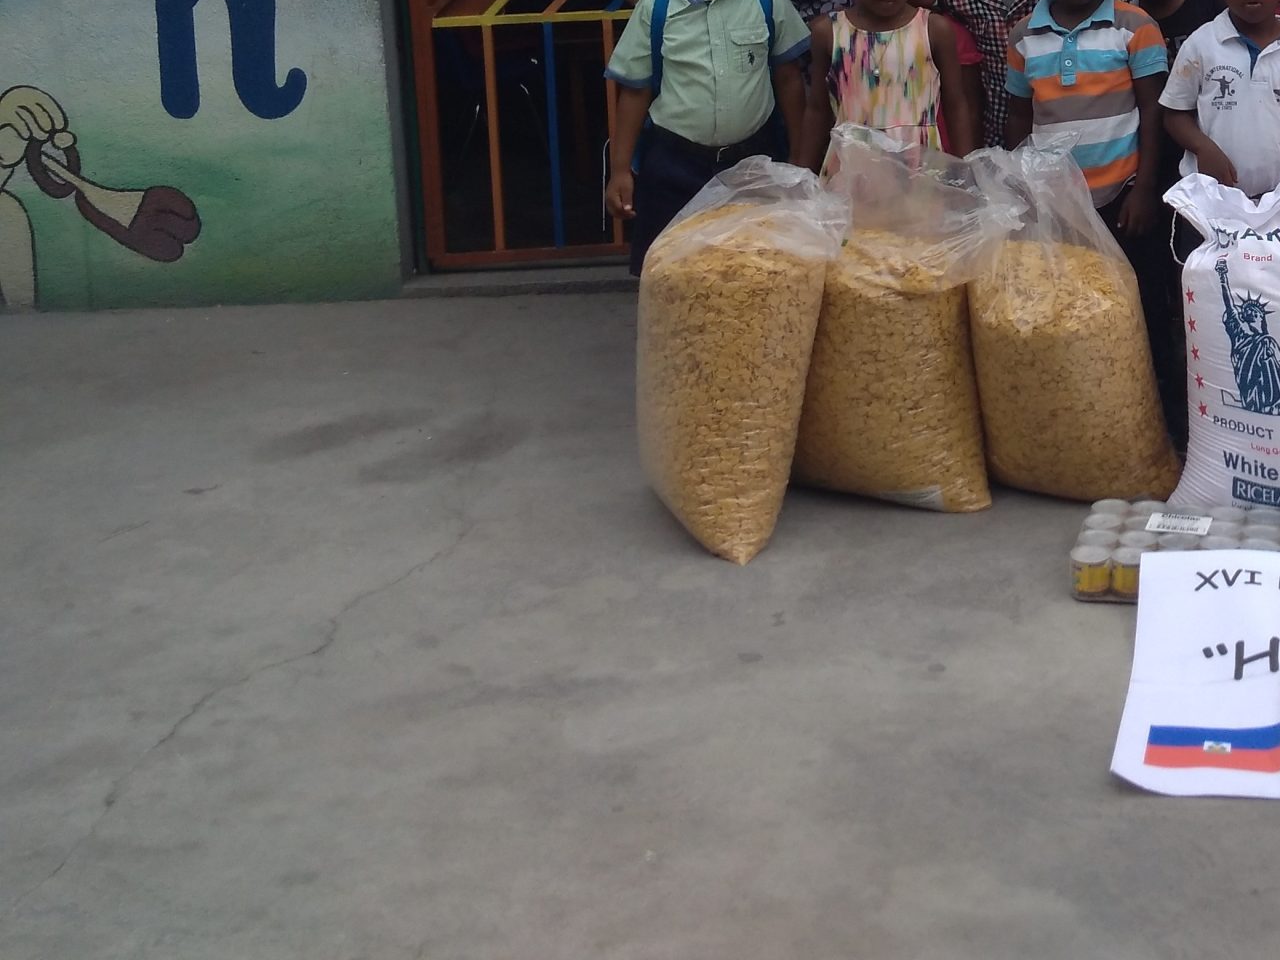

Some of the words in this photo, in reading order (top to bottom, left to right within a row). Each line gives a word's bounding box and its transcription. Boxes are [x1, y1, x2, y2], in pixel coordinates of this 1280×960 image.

[1242, 251, 1274, 263] Brand
[1213, 414, 1274, 441] PRODUCT
[1250, 442, 1271, 456] Long
[1194, 567, 1262, 593] XVI
